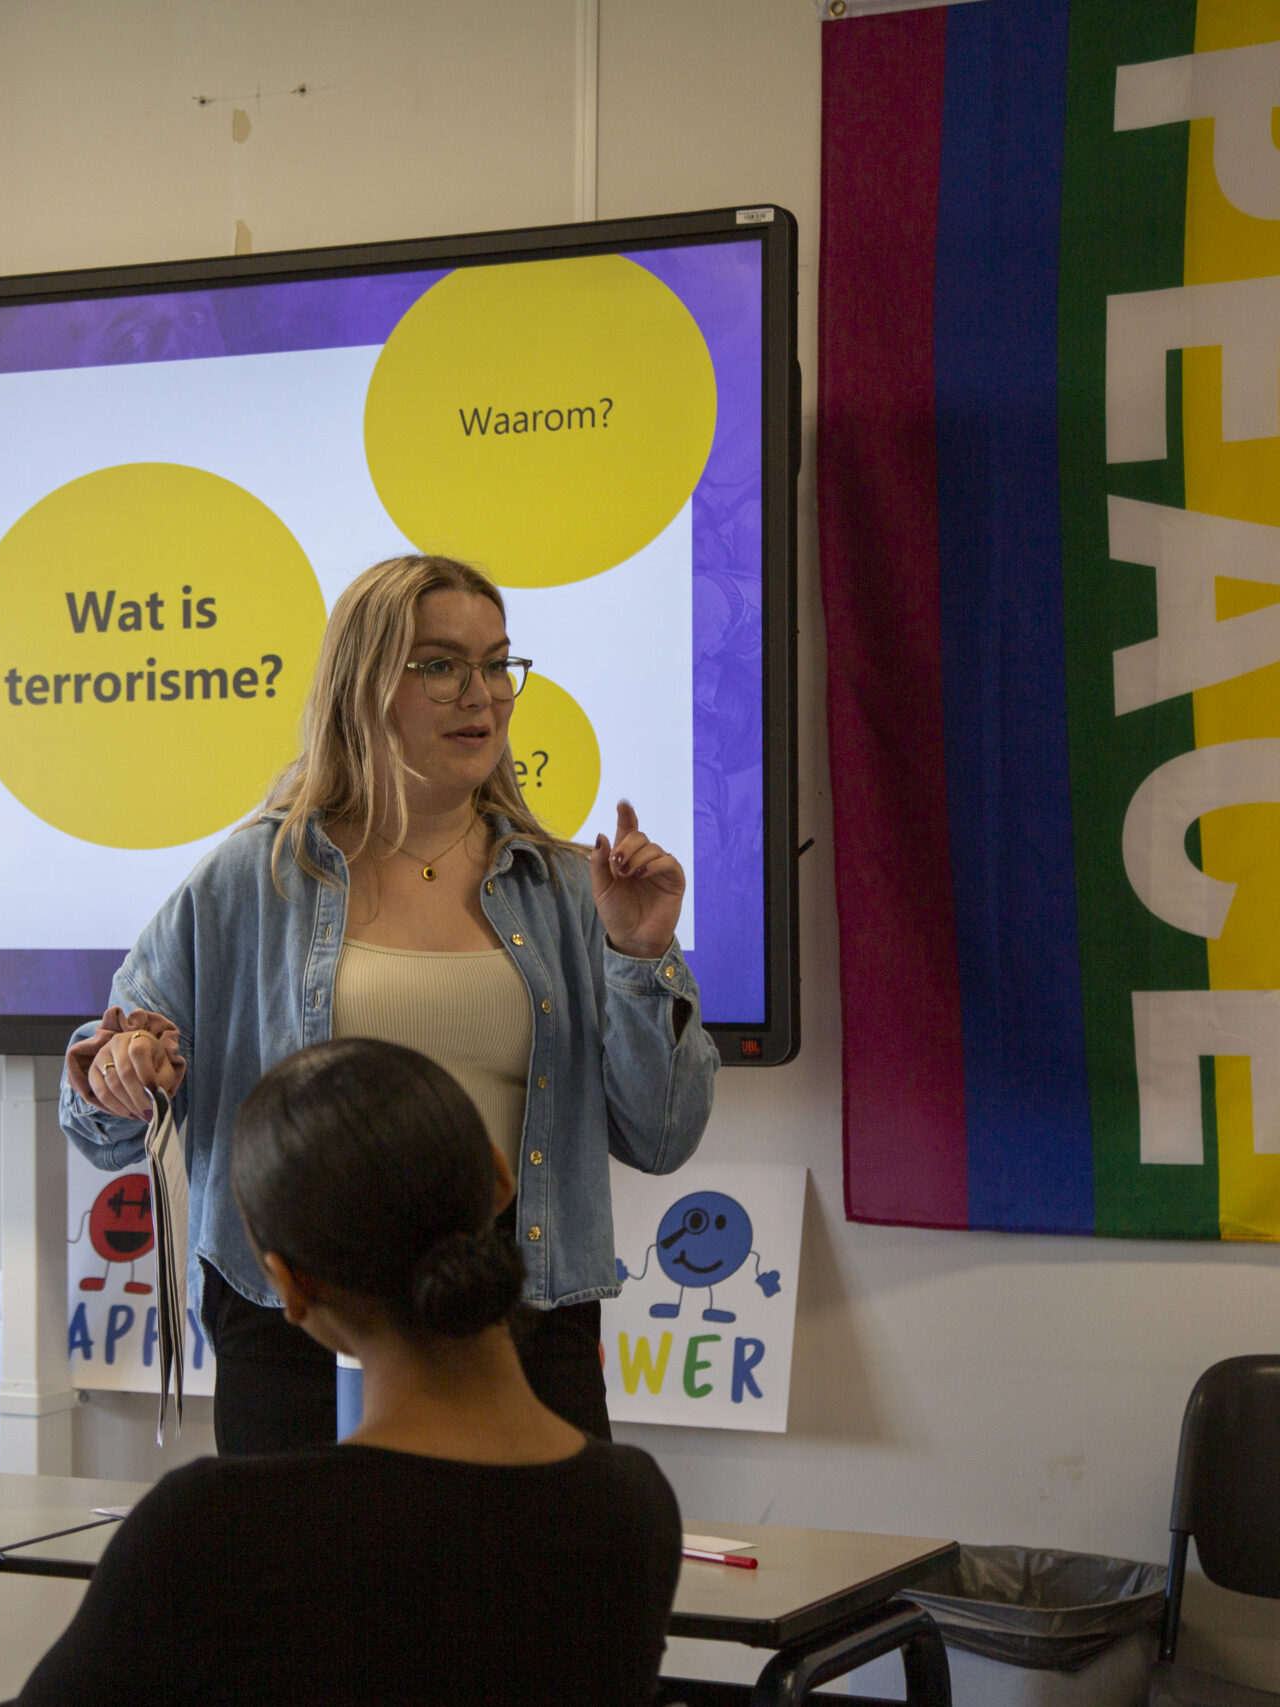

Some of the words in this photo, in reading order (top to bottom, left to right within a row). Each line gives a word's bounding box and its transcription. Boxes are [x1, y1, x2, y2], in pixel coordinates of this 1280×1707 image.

[459, 397, 613, 436] Waarom?
[65, 590, 164, 634] Wat
[182, 585, 217, 630] is
[1106, 41, 1280, 1165] PEACE
[4, 654, 283, 706] terrorisme?
[599, 1331, 766, 1404] WER
